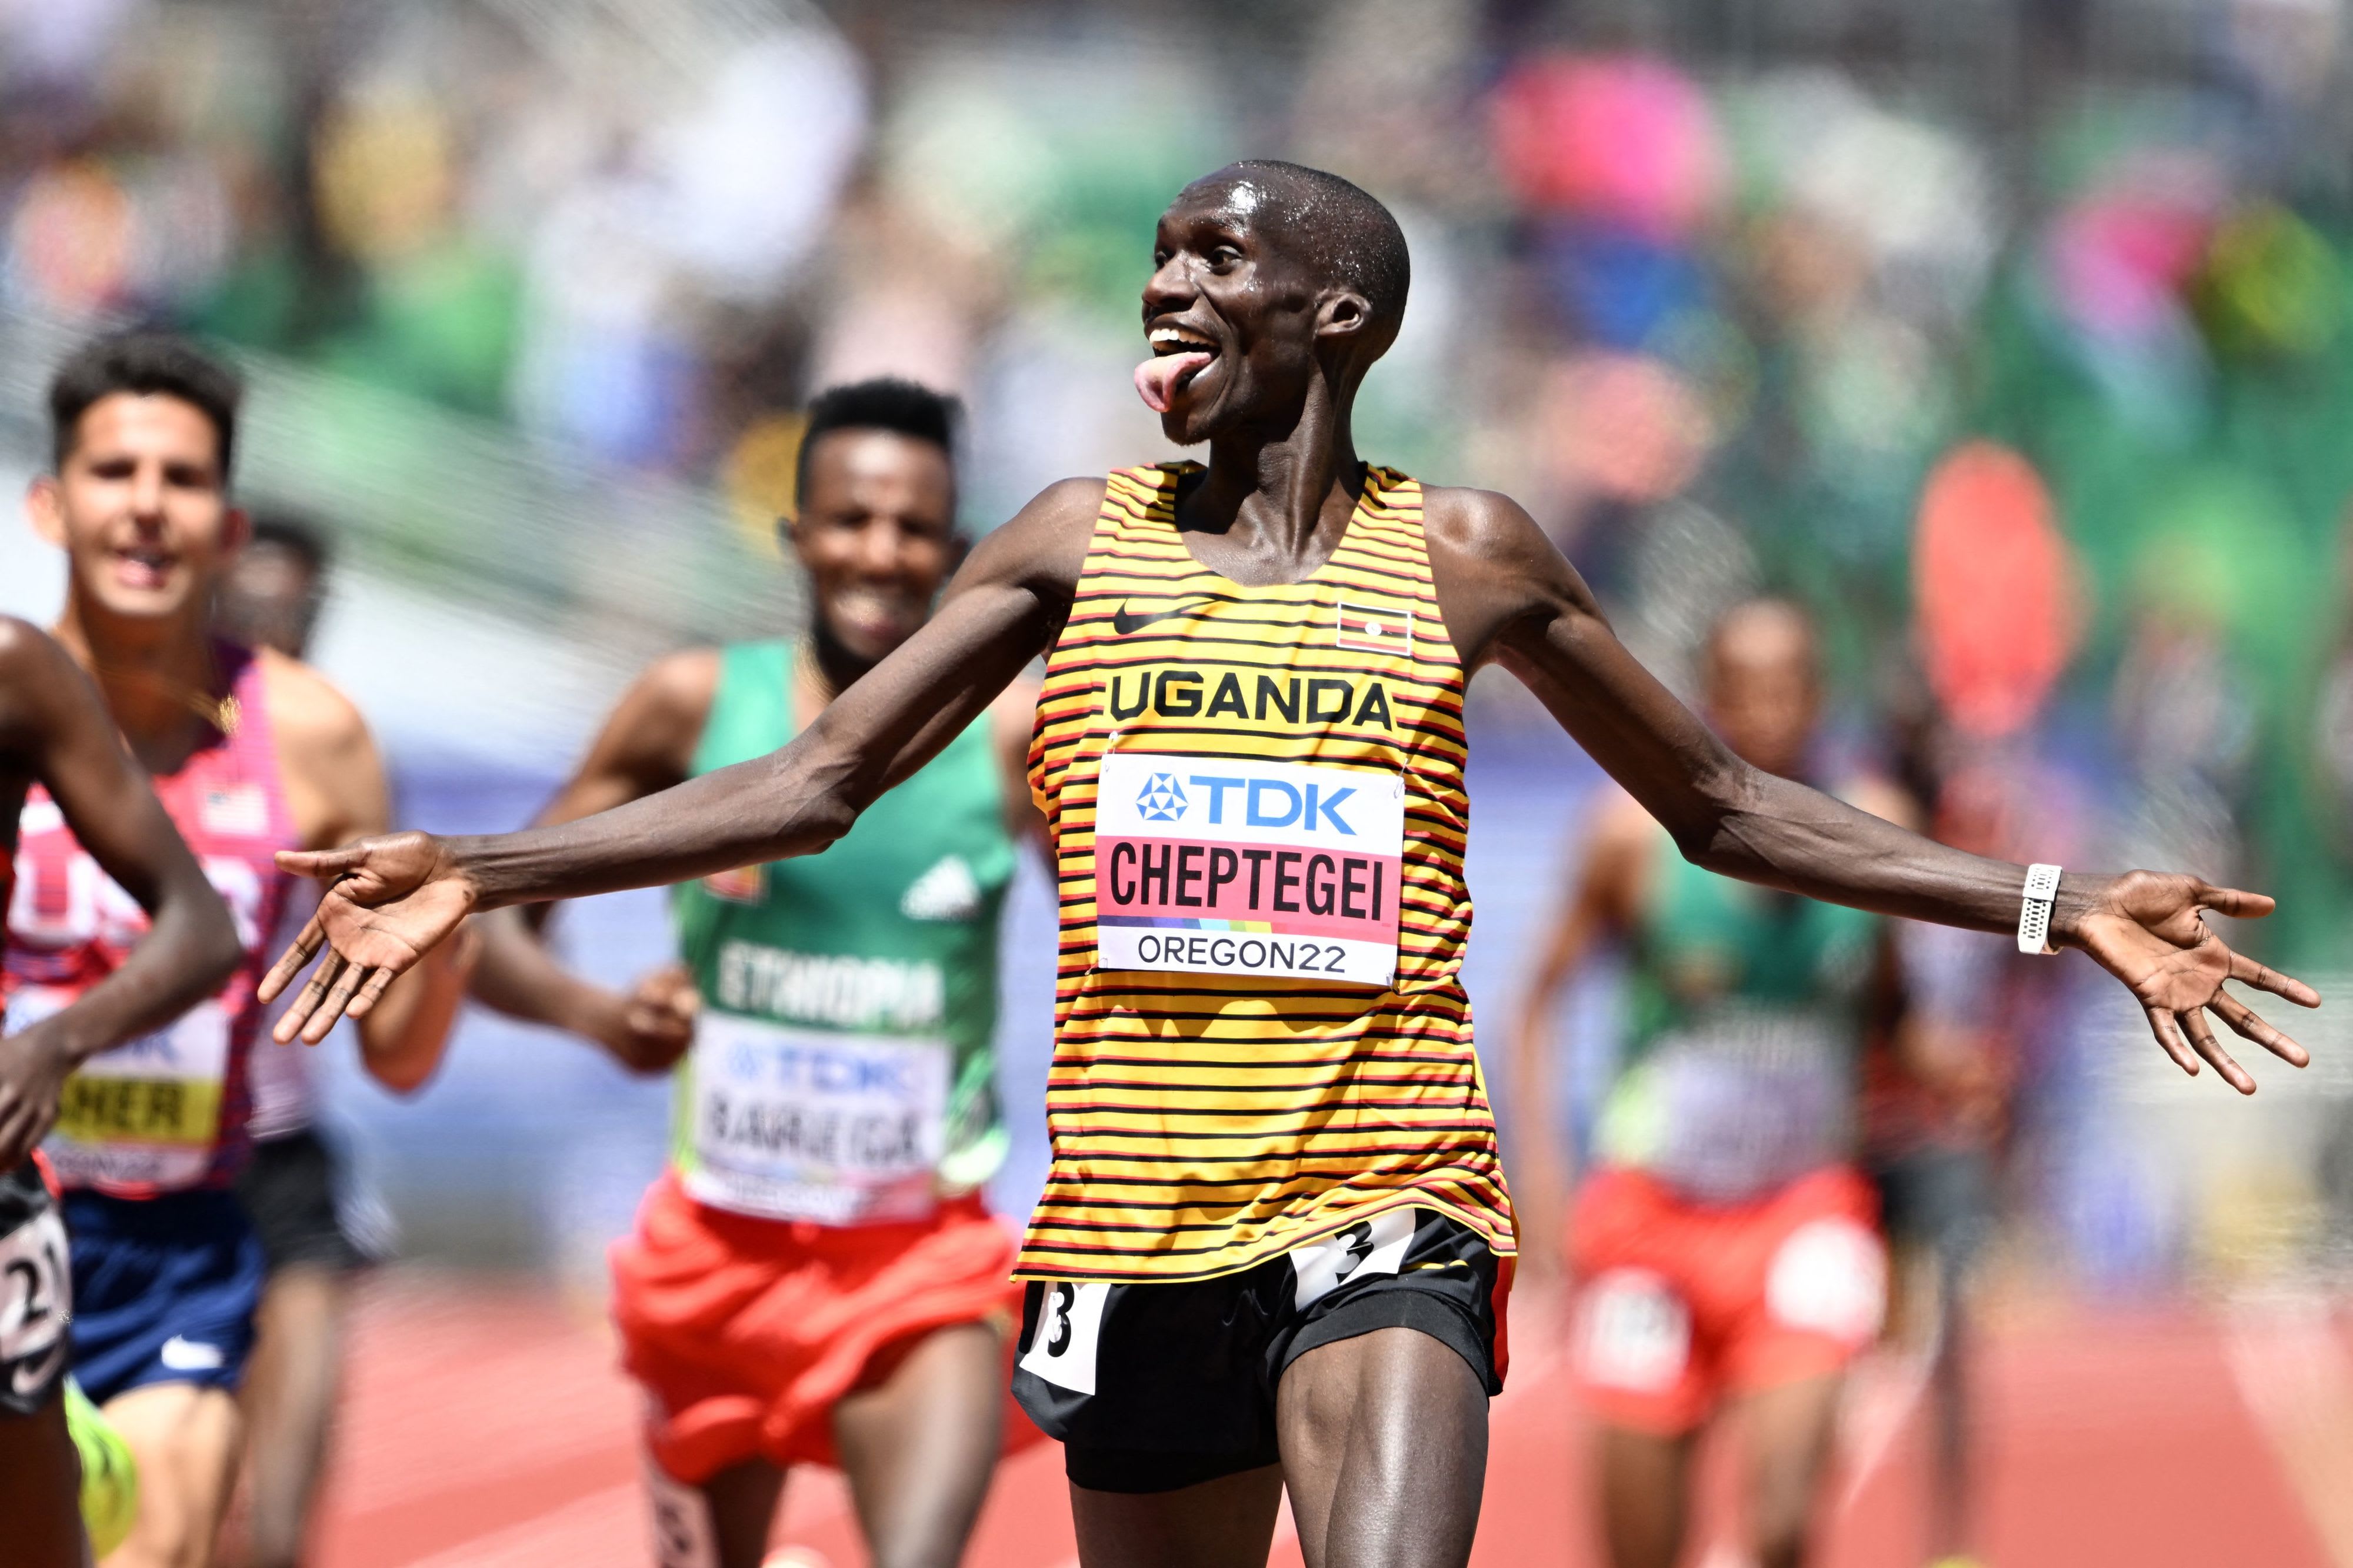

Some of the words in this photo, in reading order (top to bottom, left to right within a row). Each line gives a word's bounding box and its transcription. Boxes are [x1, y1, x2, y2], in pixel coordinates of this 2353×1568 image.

[1110, 670, 1393, 732] UGANDA
[1189, 775, 1358, 836] TDK
[1110, 842, 1384, 921] CHEPTEGEI
[1138, 935, 1347, 974] OREGON22
[62, 1080, 186, 1133] HER
[1333, 1220, 1375, 1286] 3
[1047, 1281, 1075, 1358] 3
